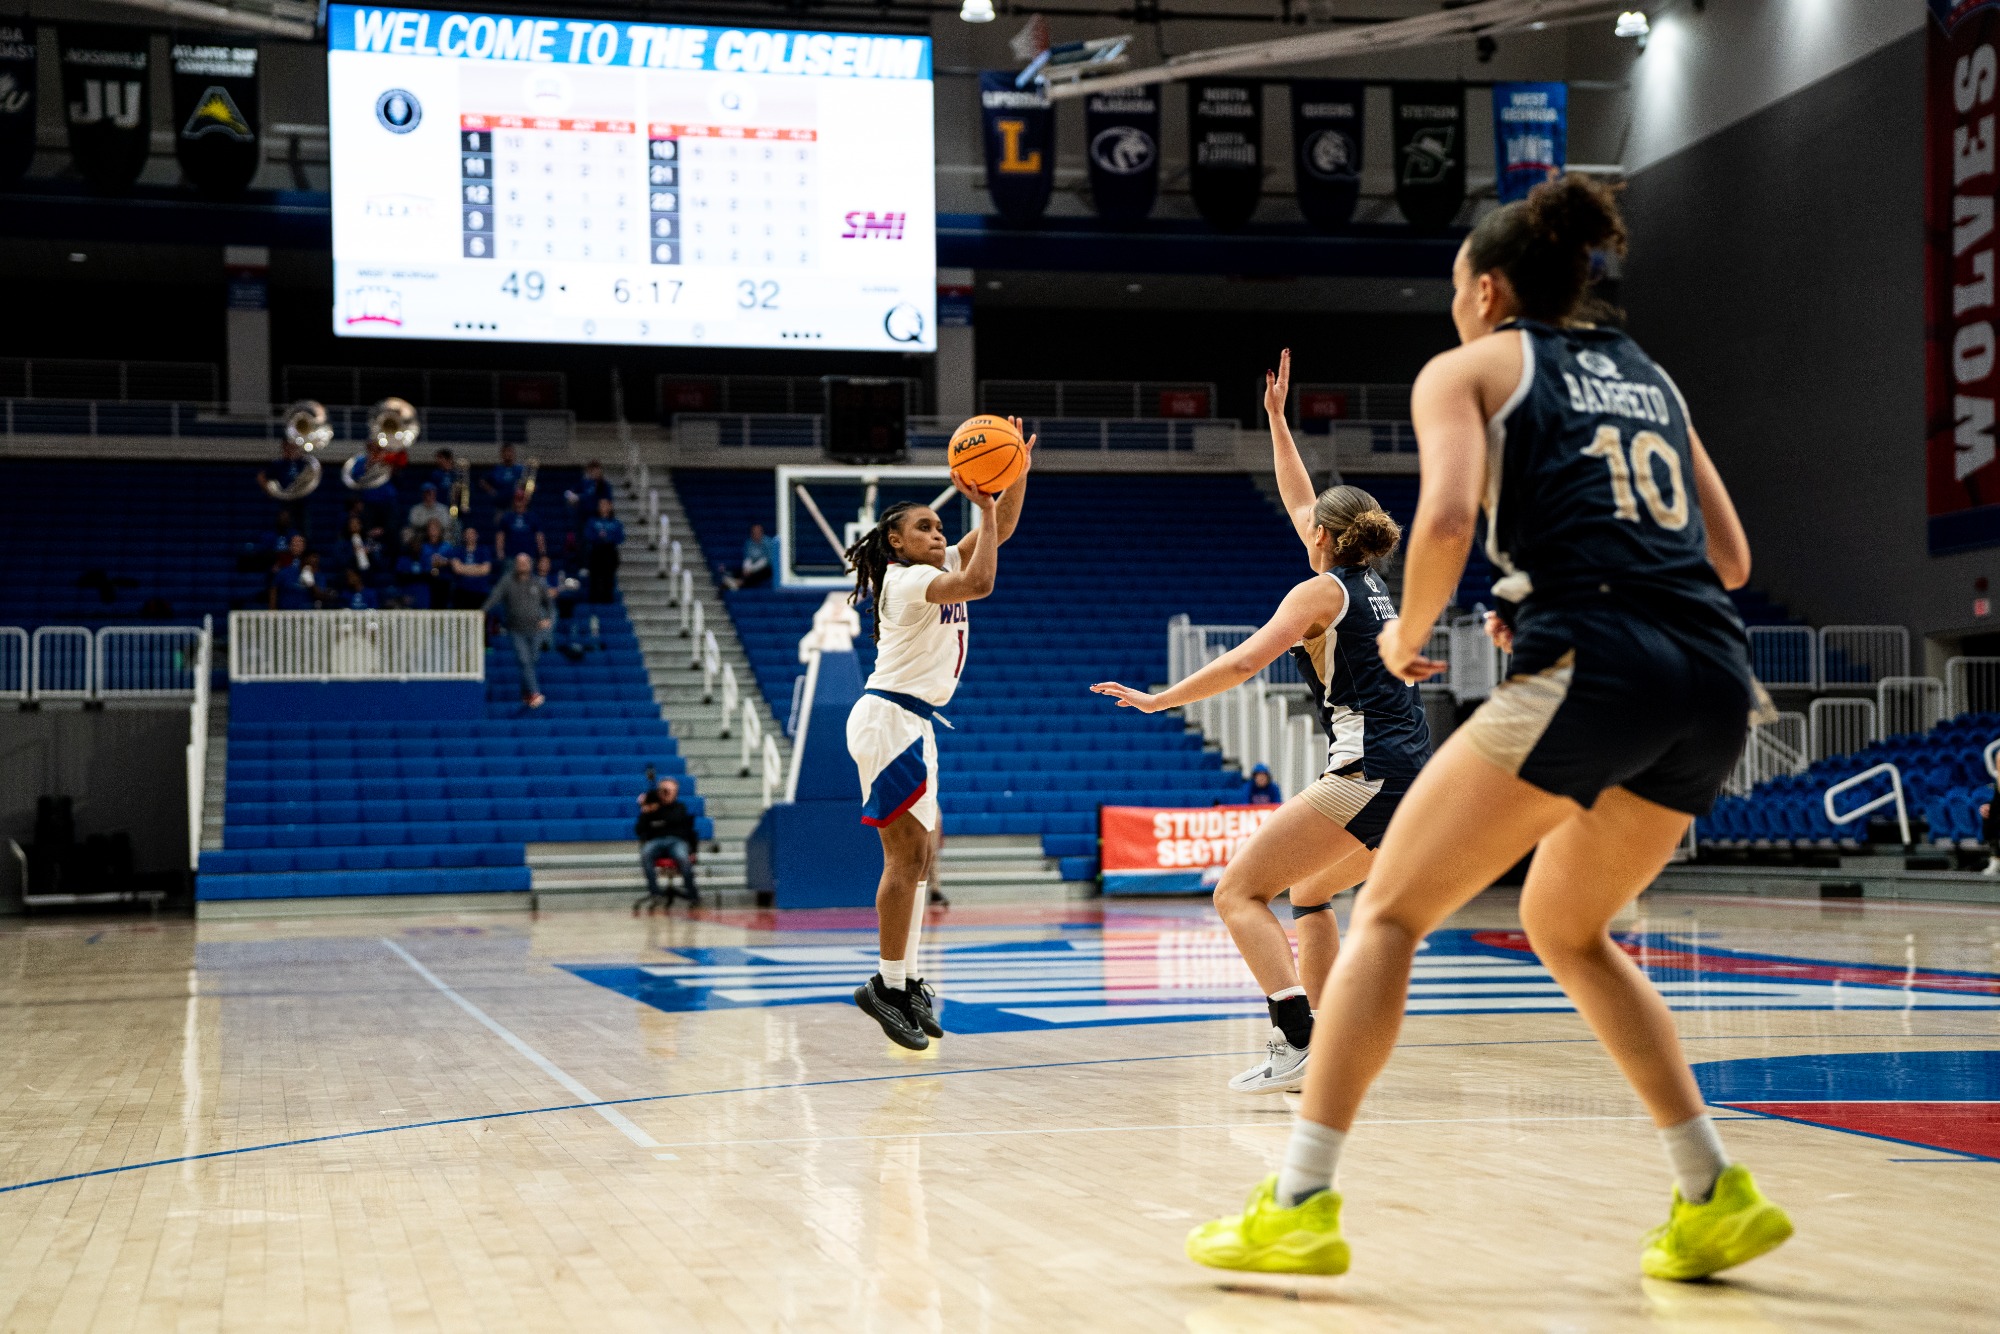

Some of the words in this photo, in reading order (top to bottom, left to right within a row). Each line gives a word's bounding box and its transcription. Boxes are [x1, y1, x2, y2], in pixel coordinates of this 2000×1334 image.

[354, 9, 559, 63] WELCOME
[565, 21, 619, 66] TO
[627, 25, 708, 69] THE
[714, 29, 923, 79] COLISEUM
[70, 79, 142, 128] JU
[467, 132, 480, 152] 1
[997, 120, 1042, 173] L
[841, 211, 906, 240] SMI
[1953, 43, 1997, 482] WOLVES
[501, 270, 546, 301] 49
[613, 278, 684, 304] 6:17
[737, 279, 780, 310] 32
[884, 303, 924, 344] Q
[1562, 372, 1670, 426] BARRETO
[954, 433, 987, 456] NCAA
[1579, 424, 1689, 532] 10
[939, 603, 968, 625] WOL
[953, 629, 965, 678] 1
